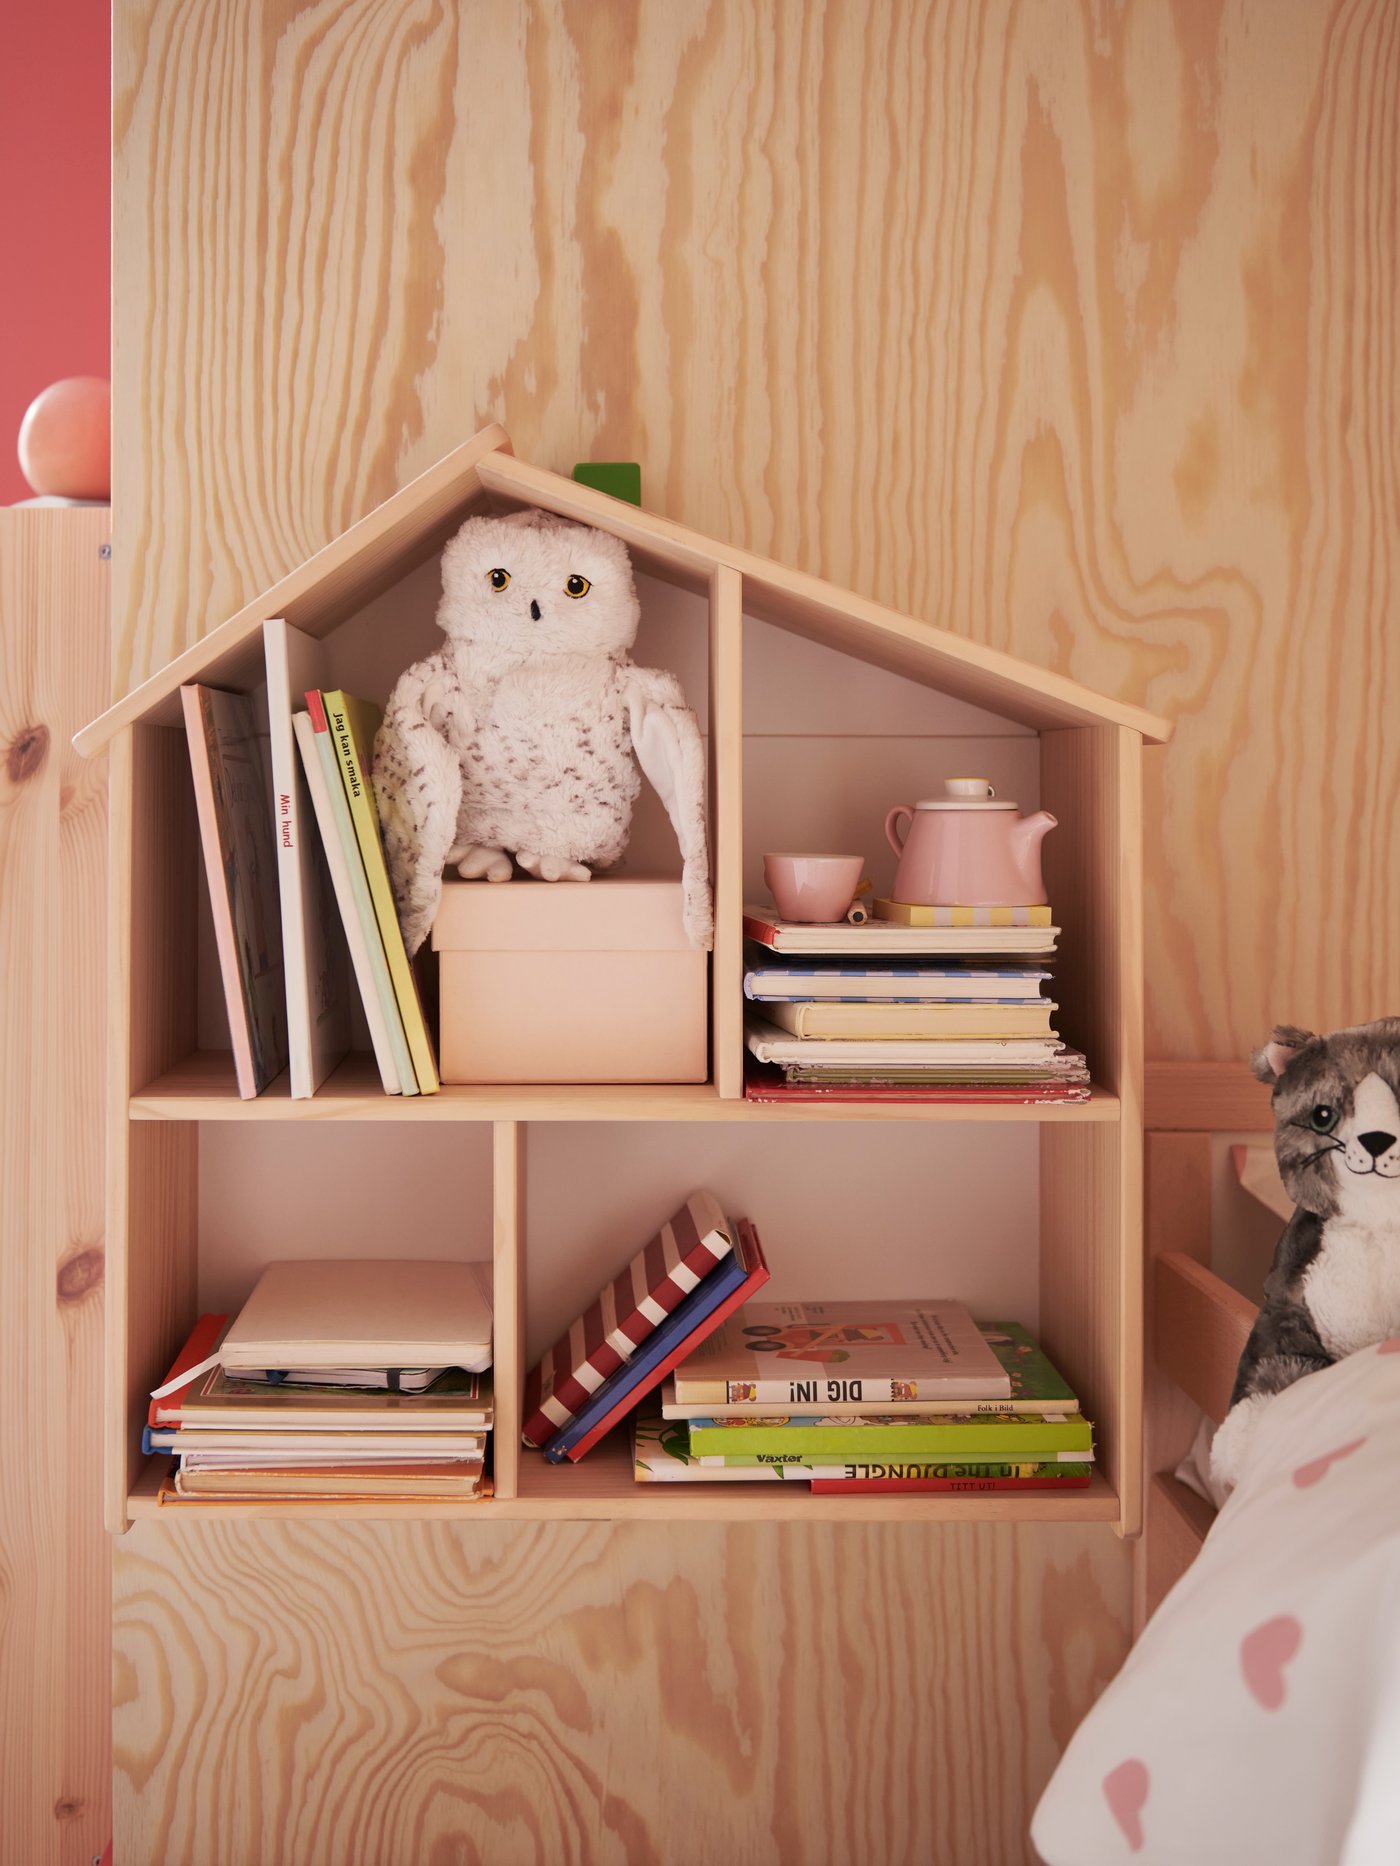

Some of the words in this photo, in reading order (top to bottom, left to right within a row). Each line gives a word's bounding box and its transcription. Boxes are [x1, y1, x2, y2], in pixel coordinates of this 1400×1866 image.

[333, 713, 345, 732] Jag
[340, 734, 351, 757] kan
[346, 759, 361, 797] smaka
[280, 794, 290, 815] Min
[282, 820, 293, 848] hund
[790, 1381, 818, 1402] IN!
[827, 1380, 863, 1402] DIG
[977, 1404, 993, 1412] Folk
[999, 1404, 1014, 1412] Bild
[844, 1464, 948, 1479] DJUNGLE
[1000, 1464, 1020, 1479] In
[950, 1482, 976, 1491] TITT
[978, 1481, 996, 1490] UT!
